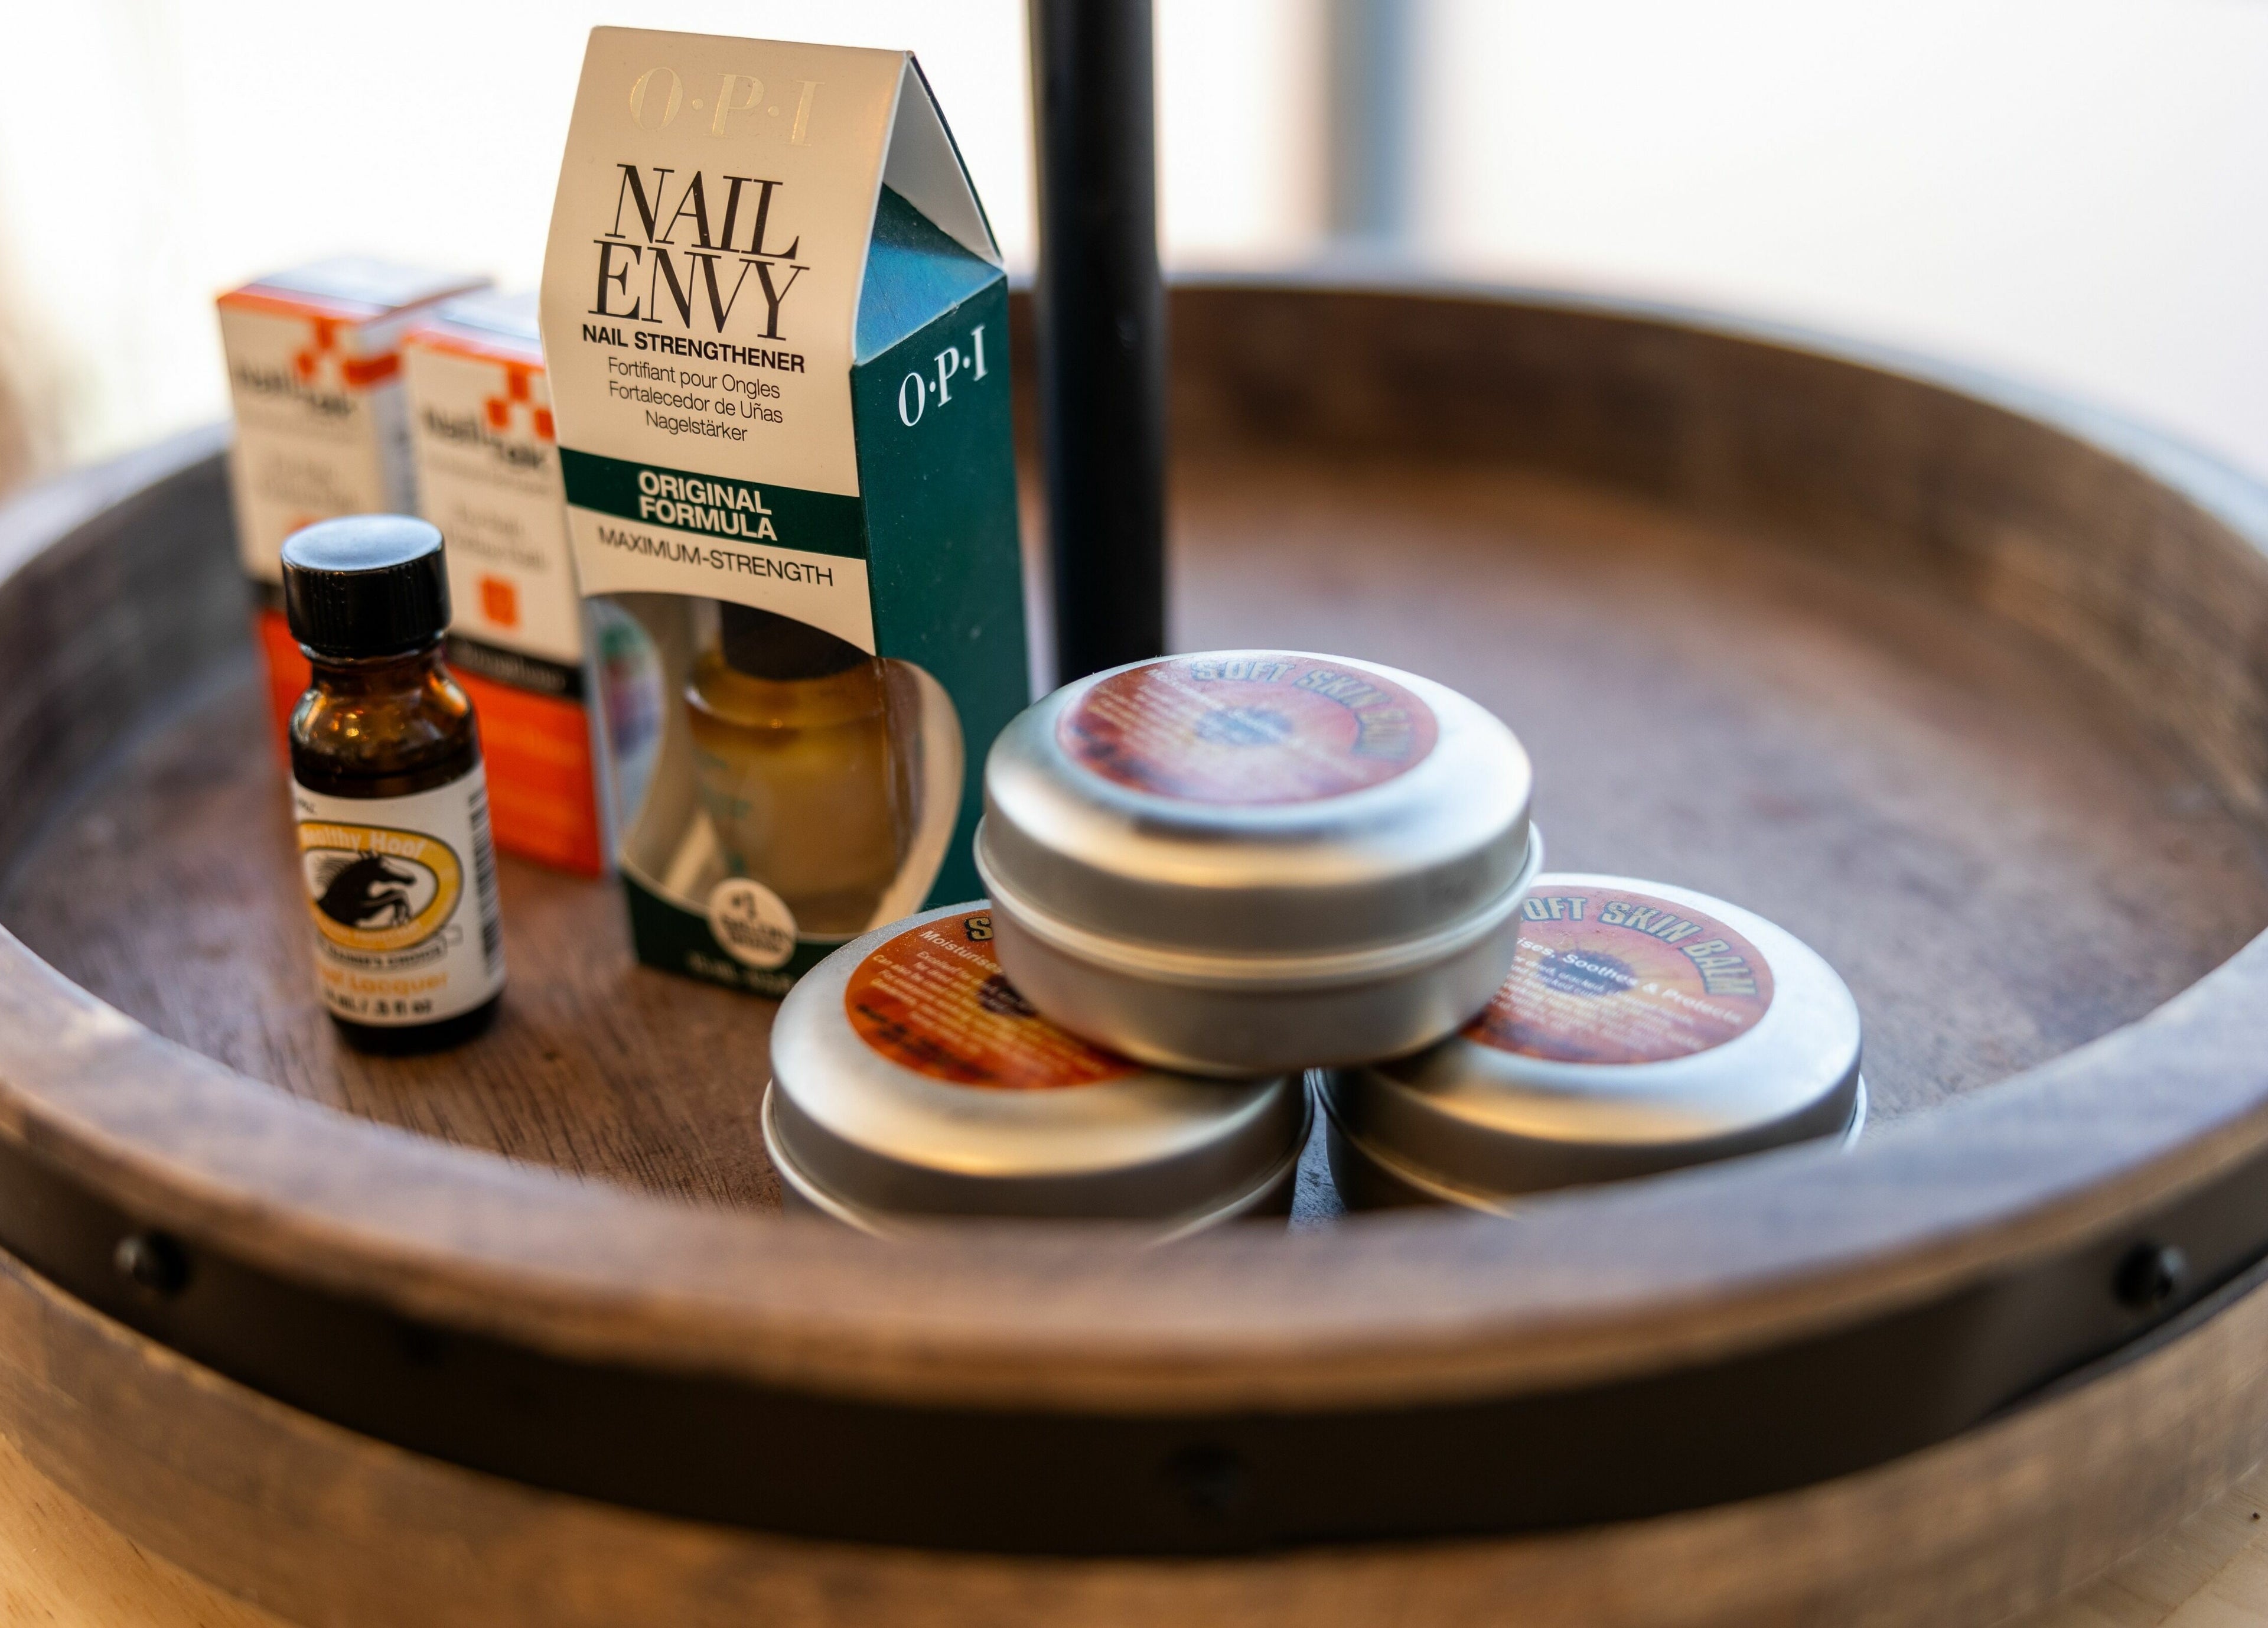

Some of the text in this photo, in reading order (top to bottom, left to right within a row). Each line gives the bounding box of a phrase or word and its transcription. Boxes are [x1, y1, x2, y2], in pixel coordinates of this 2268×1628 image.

[604, 163, 800, 260] NAIL
[588, 239, 810, 341] ENVY
[582, 323, 806, 374] NAIL STRENGTHENER
[608, 356, 781, 399] Fortifiant pour Ongles
[609, 380, 784, 424] Fortalecedor de Uñas
[645, 409, 748, 441] Nagelstärker
[638, 470, 773, 516] ORIGINAL
[638, 494, 778, 542] FORMULA
[597, 525, 834, 587] MAXIMUM-STRENGTH
[1520, 897, 1588, 922] OFT
[1598, 901, 1703, 945] SKIN
[1562, 953, 1639, 987] Soothes
